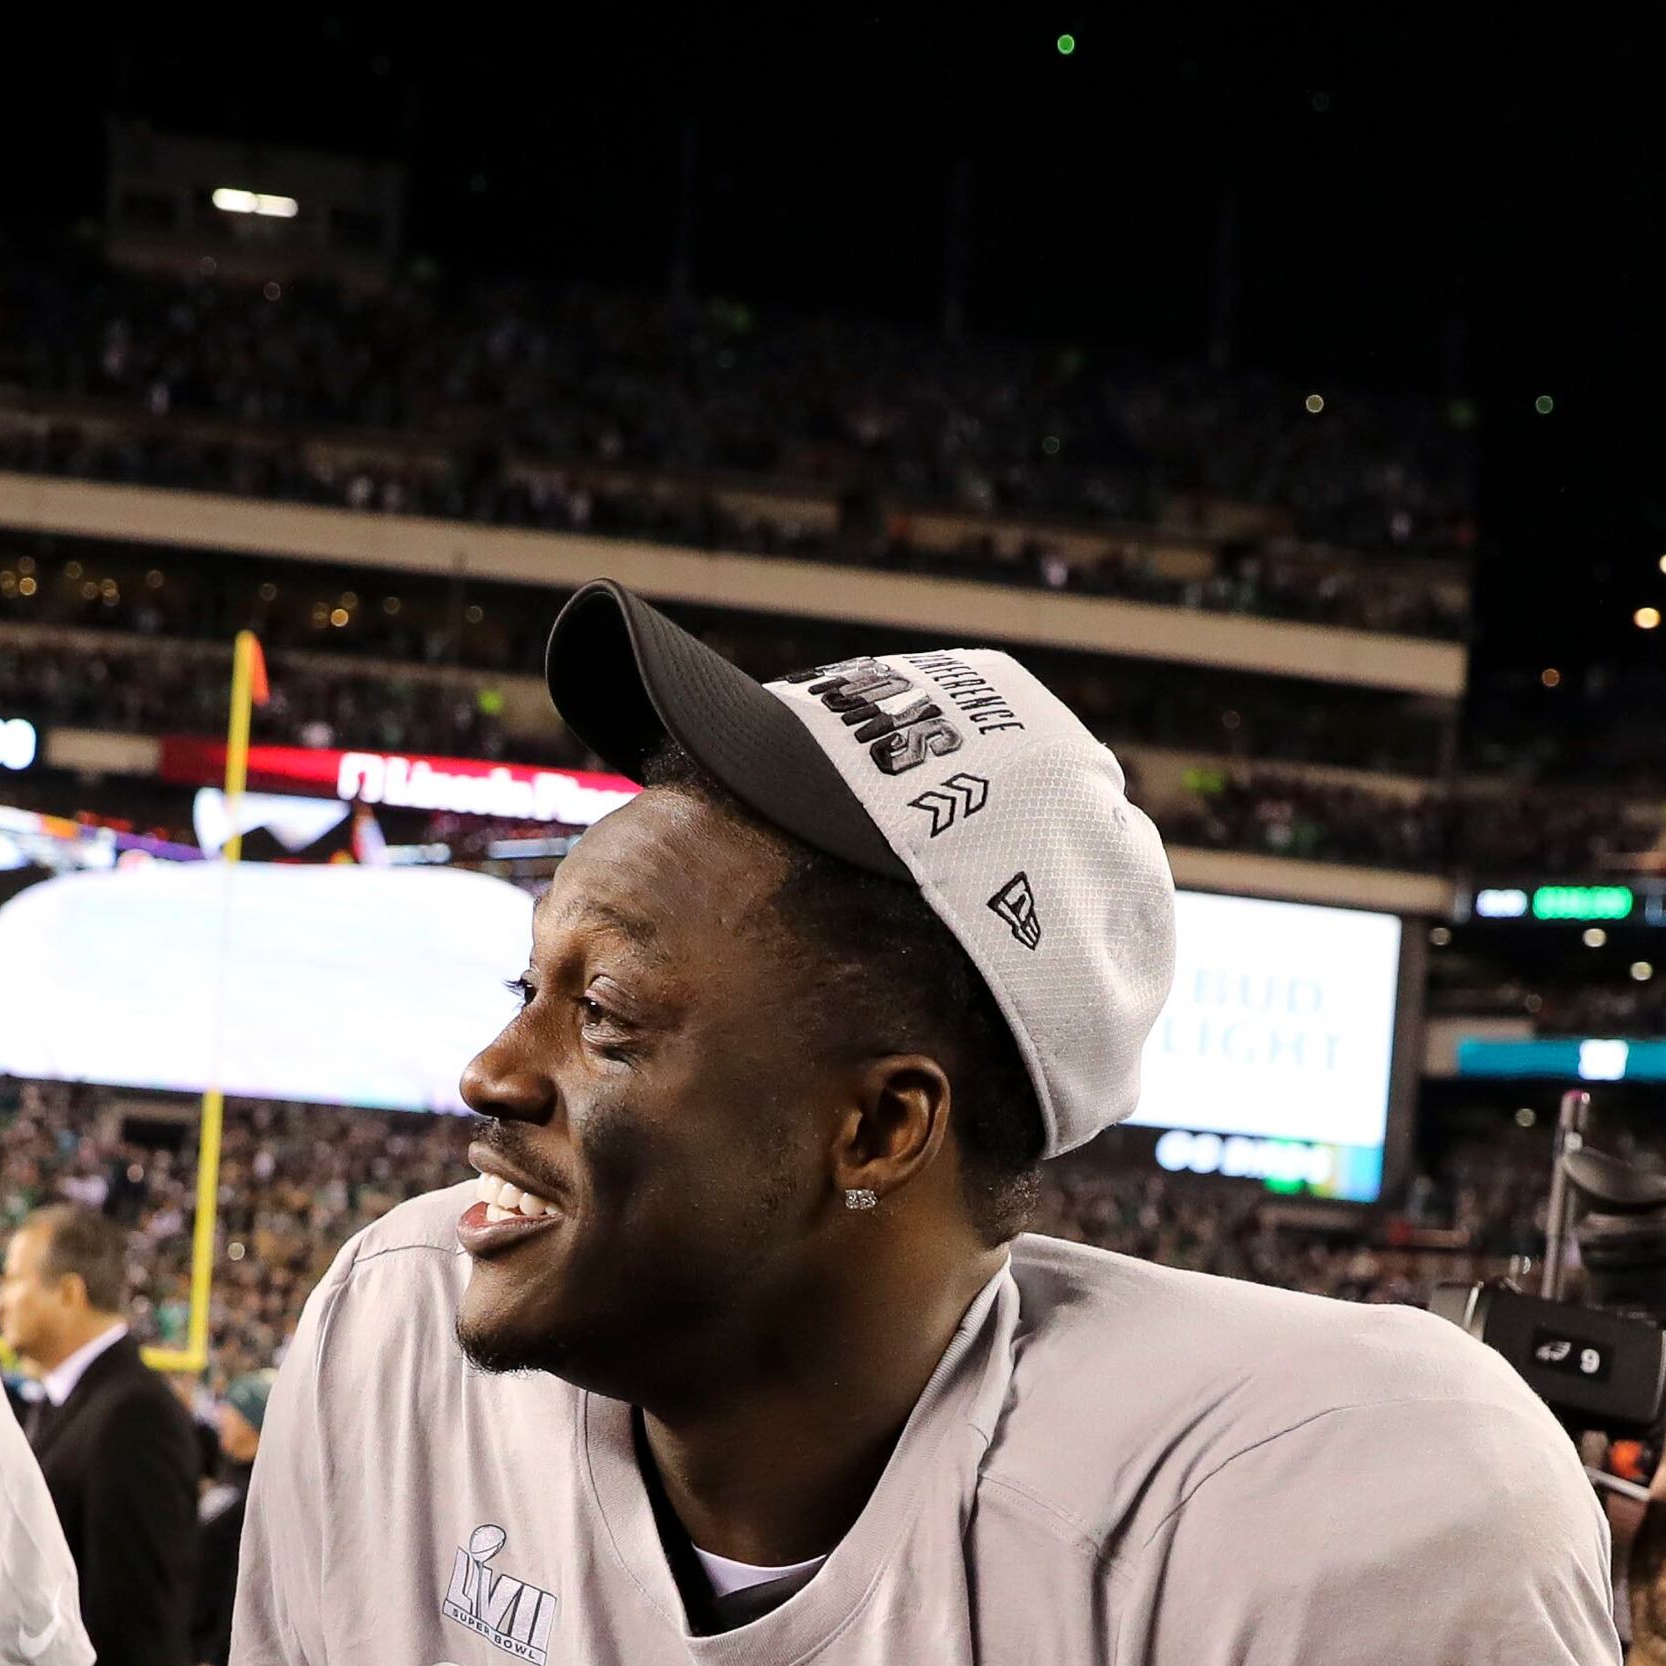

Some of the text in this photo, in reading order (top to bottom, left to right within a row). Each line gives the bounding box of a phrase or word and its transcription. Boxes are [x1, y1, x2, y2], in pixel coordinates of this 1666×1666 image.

[1193, 965, 1327, 1015] BUD
[1161, 1015, 1342, 1072] LIGHT
[452, 1607, 536, 1660] SUPER BOWL
